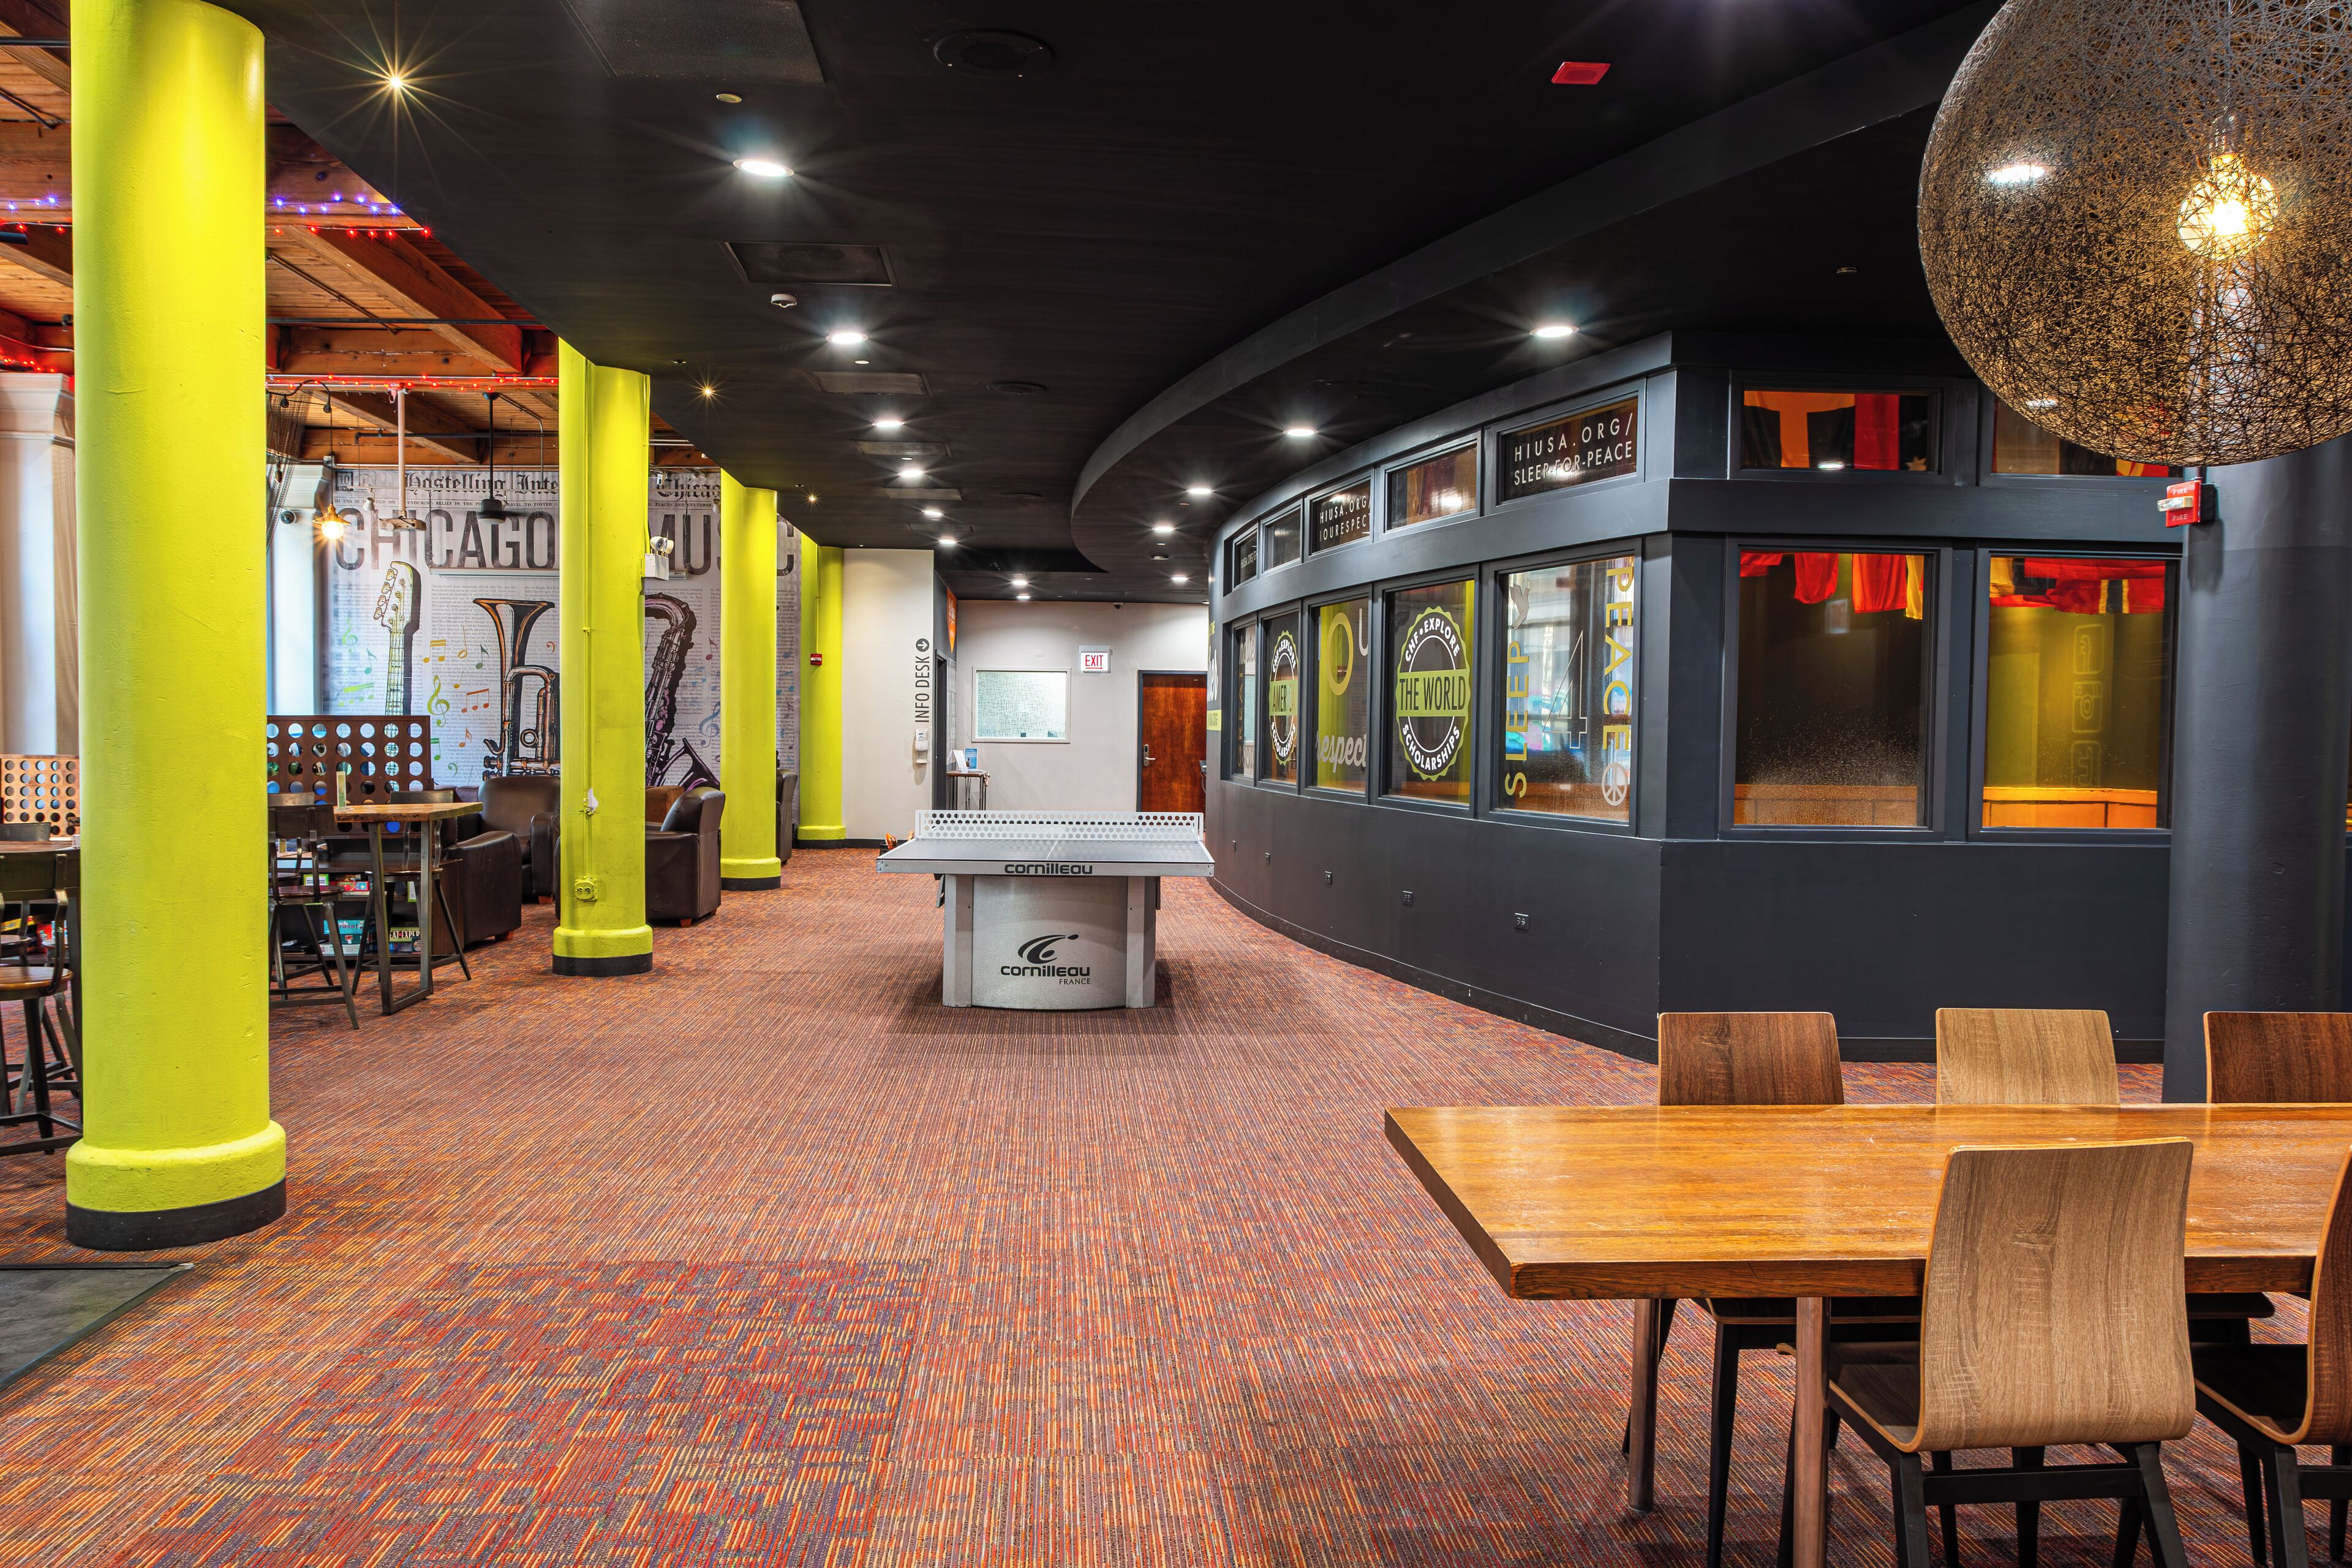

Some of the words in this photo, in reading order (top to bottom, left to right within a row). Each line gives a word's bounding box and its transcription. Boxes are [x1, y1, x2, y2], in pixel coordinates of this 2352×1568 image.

[1515, 412, 1633, 462] HIUSA.ORG/
[1514, 440, 1632, 486] SLEEP-FOR-PEACE
[514, 474, 559, 494] Inte
[2173, 487, 2188, 496] FIRE
[336, 507, 556, 570] CHICAGO
[915, 656, 930, 688] DESK
[1085, 655, 1104, 666] EXIT
[1603, 567, 1634, 750] PEACE
[915, 693, 930, 723] INFO
[1399, 677, 1420, 710] THE
[1423, 676, 1466, 710] WORLD
[1505, 640, 1529, 798] SLEEP
[1402, 724, 1460, 771] SCHOLARSHIPS
[1004, 863, 1093, 875] cornilleau
[1000, 965, 1090, 977] cornilleau
